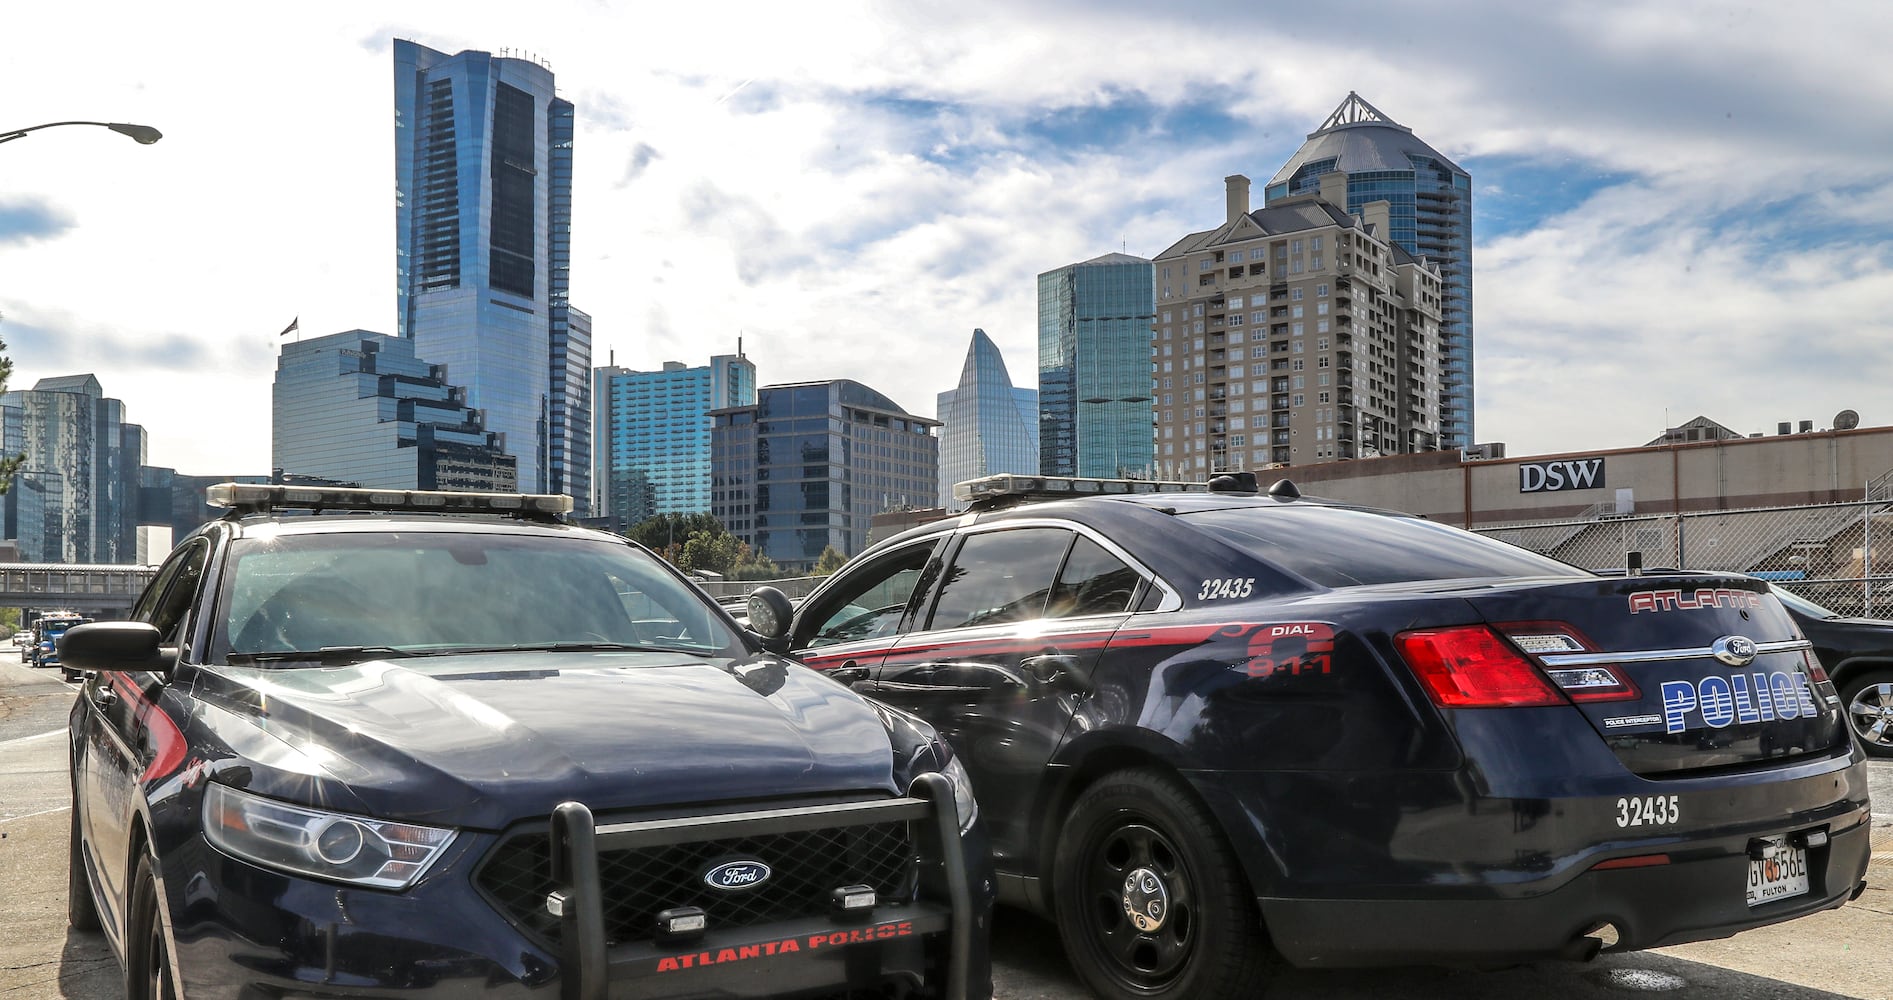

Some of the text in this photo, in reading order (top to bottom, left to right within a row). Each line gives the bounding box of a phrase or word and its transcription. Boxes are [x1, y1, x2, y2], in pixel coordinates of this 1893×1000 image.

[1520, 459, 1602, 491] DSW
[1197, 577, 1256, 601] 32435
[1628, 588, 1761, 615] ATLANTA
[1271, 624, 1315, 636] DIAL
[1732, 639, 1751, 654] Ford
[1247, 655, 1331, 677] 9-1-1
[1660, 671, 1817, 734] POLICE
[1616, 795, 1680, 828] 32435
[722, 867, 757, 885] Ford
[1762, 885, 1787, 897] FULTON
[656, 922, 913, 973] ATLANTA POLICE
